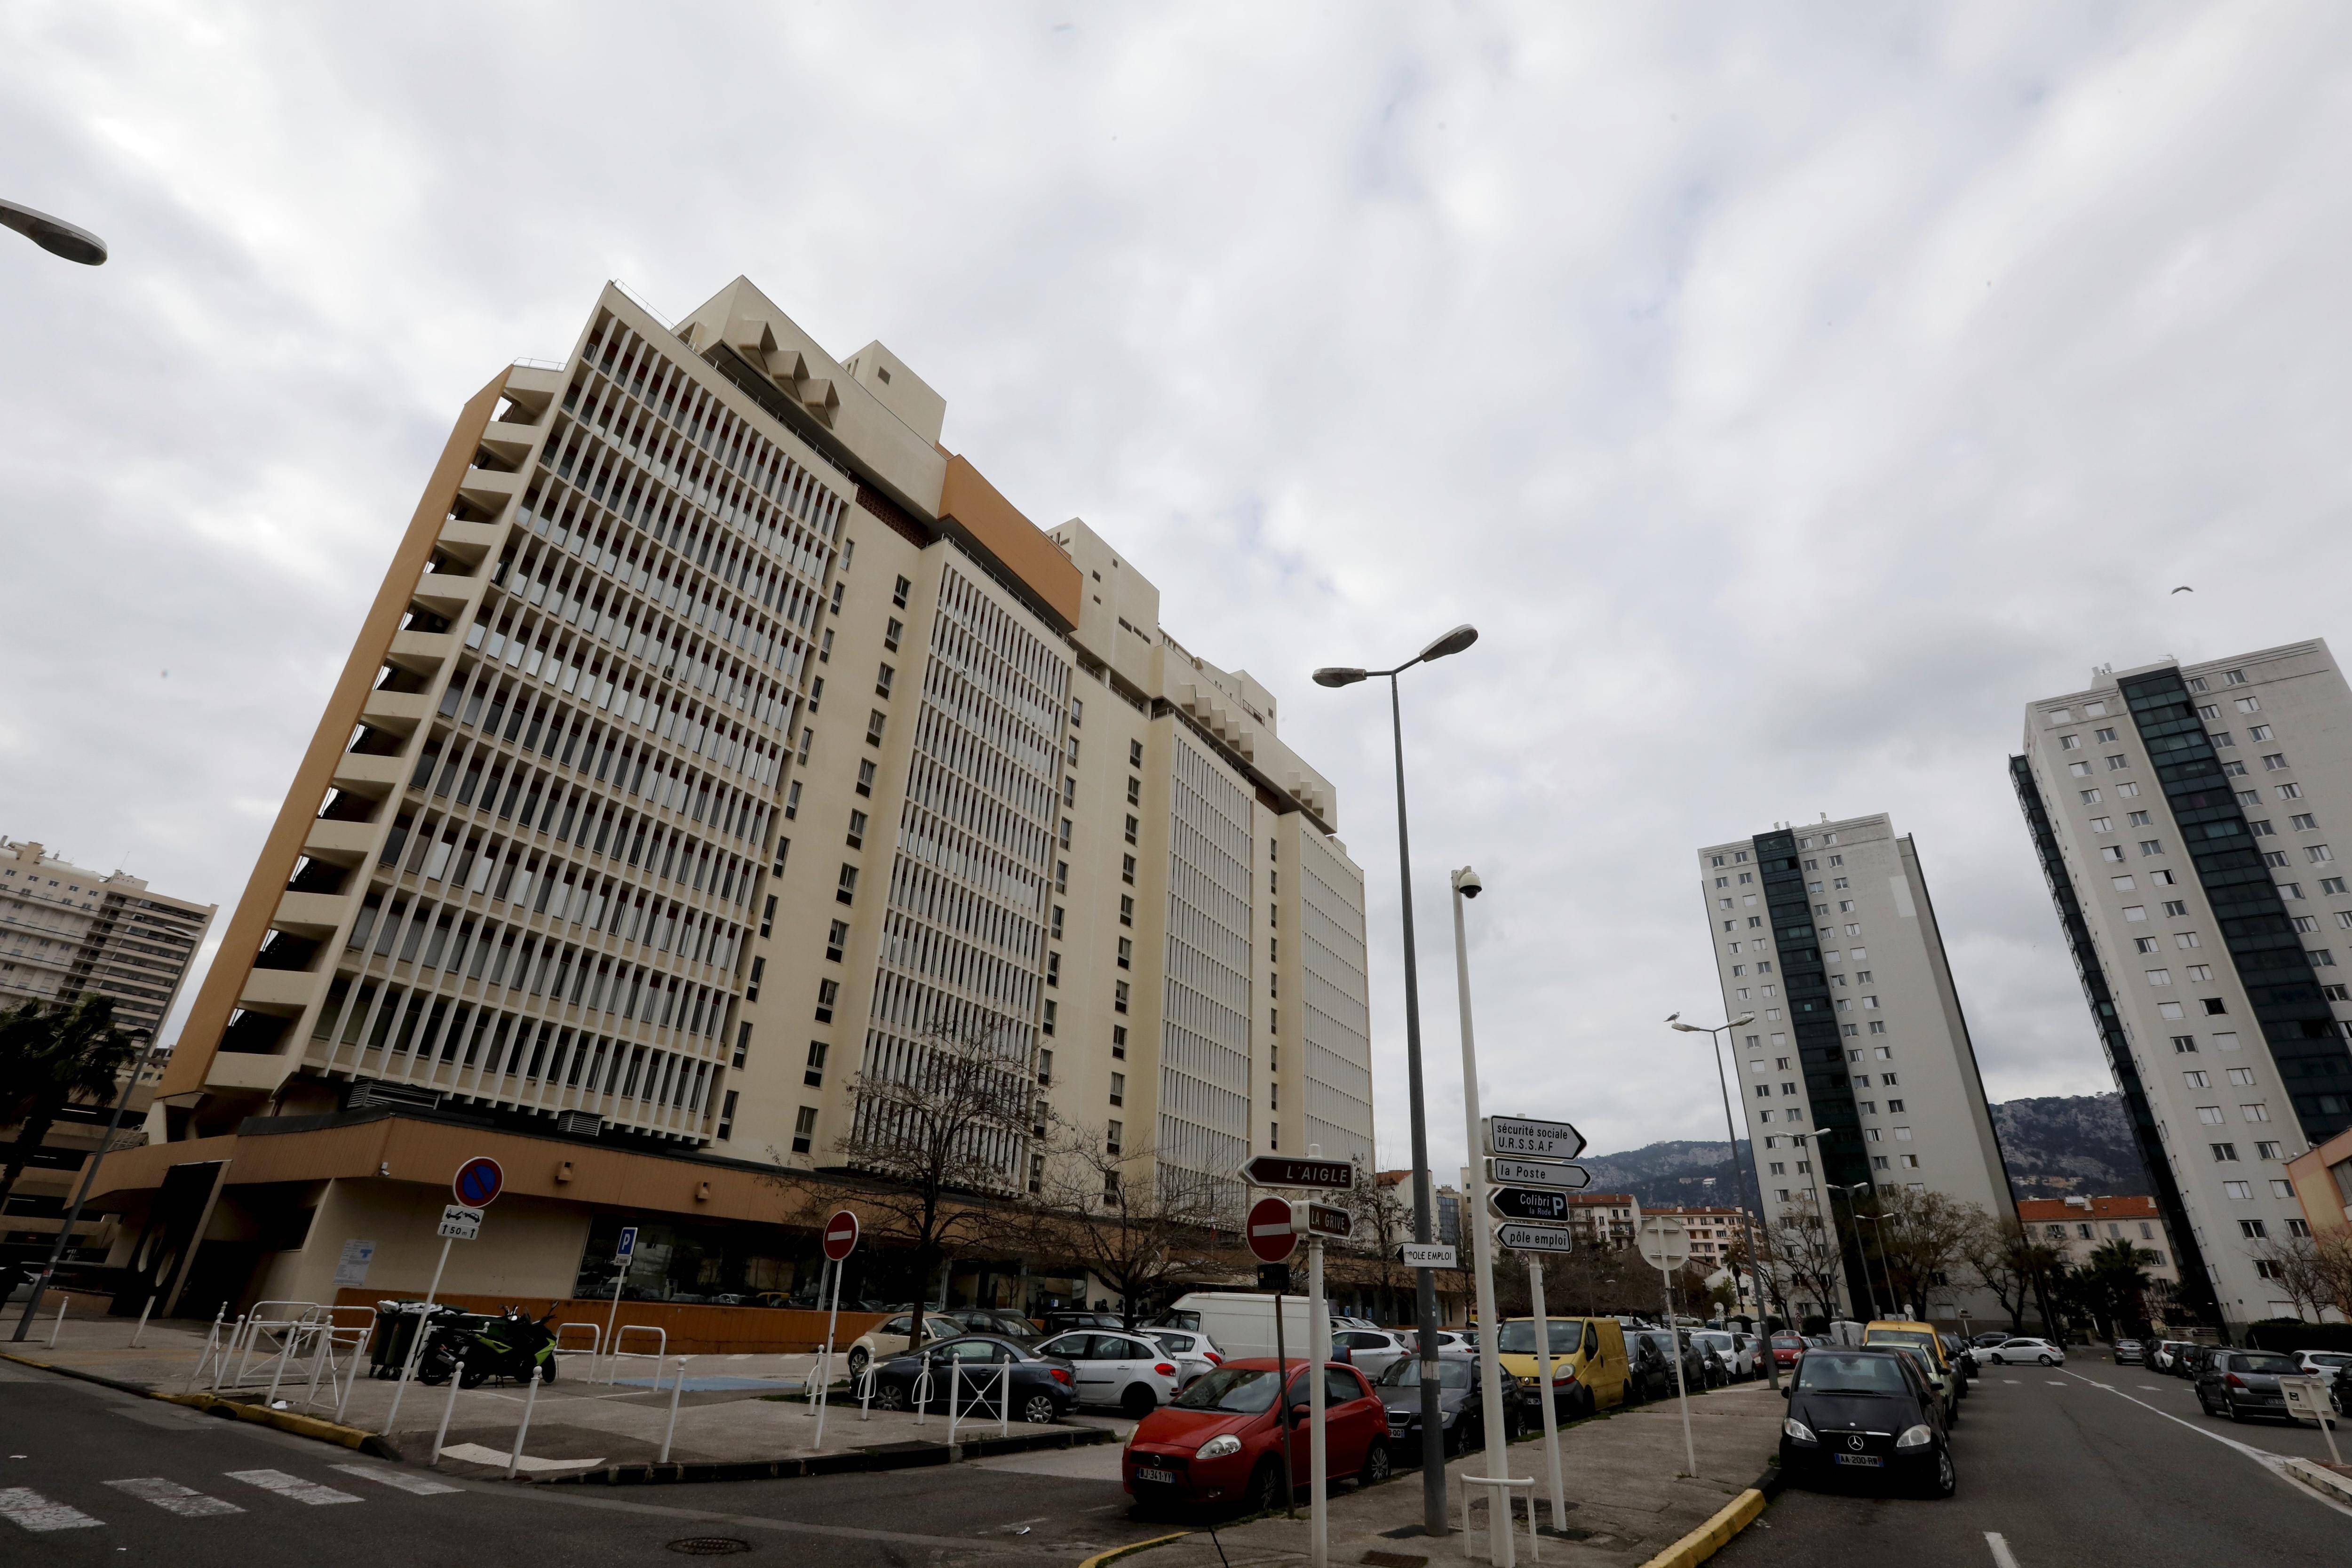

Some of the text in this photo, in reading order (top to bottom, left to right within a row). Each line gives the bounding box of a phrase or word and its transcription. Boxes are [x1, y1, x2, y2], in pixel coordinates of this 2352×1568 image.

[1497, 1123, 1567, 1139] sécurité sociale
[1287, 1166, 1347, 1183] L'AIGLE
[1501, 1164, 1546, 1179] la Poste
[1520, 1193, 1549, 1207] Colibri
[1553, 1196, 1564, 1216] P
[1311, 1210, 1344, 1231] LA GRIVE
[450, 1226, 461, 1235] 50
[621, 1234, 630, 1250] P
[1510, 1231, 1566, 1248] pôle emploi
[1428, 1251, 1451, 1260] EMPLOI
